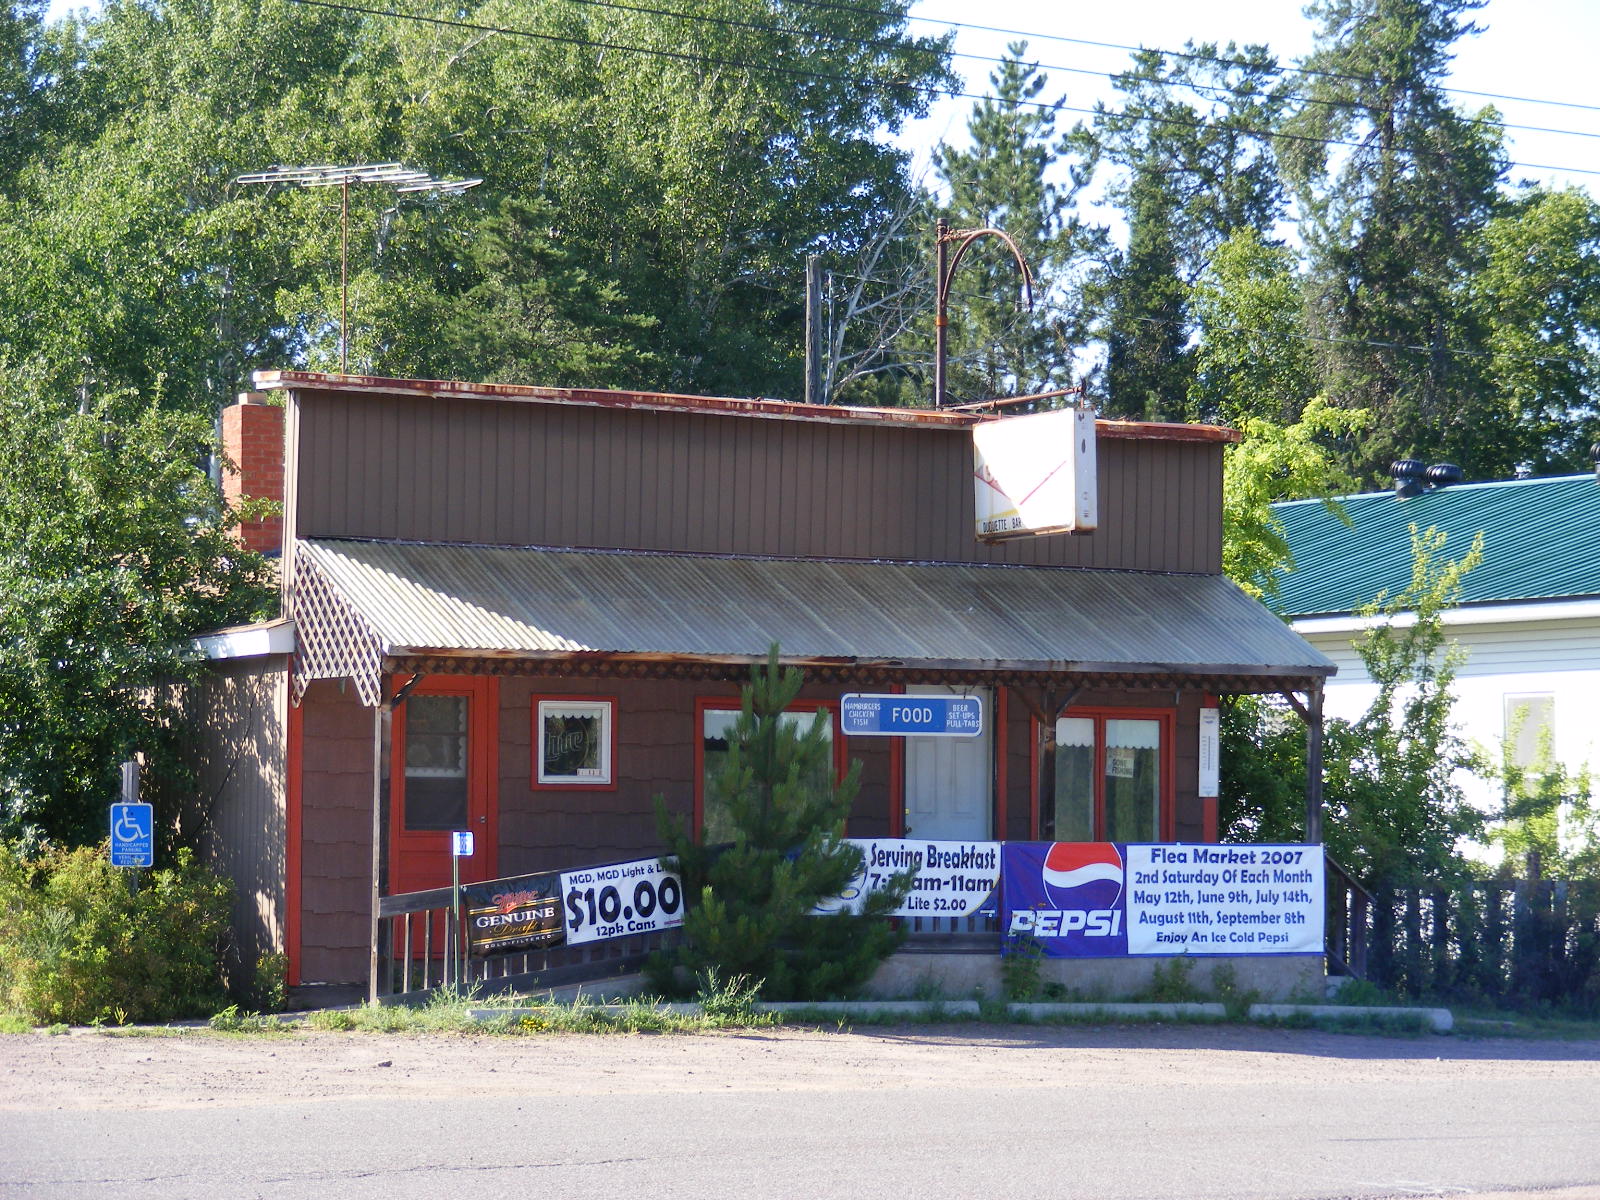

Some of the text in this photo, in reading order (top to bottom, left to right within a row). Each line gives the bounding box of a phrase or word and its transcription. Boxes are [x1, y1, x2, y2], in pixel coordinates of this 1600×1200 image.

[1012, 516, 1022, 529] BAR
[844, 702, 881, 711] HAMBURGERS
[849, 710, 875, 718] CHICKEN
[952, 704, 969, 712] BEER
[853, 718, 869, 726] FISH
[892, 707, 933, 723] FOOD
[948, 711, 976, 719] SET-UPS
[946, 719, 980, 728] PULL-TABS
[870, 842, 996, 871] Serving Breakfast
[1151, 848, 1303, 864] Flea Market 2007
[569, 874, 595, 885] MGD,
[597, 870, 620, 881] MGD
[622, 867, 645, 878] Light
[647, 864, 654, 874] &
[1135, 869, 1313, 886] 2nd Saturday Of Each Month
[566, 876, 681, 933] $10.00
[908, 897, 930, 910] Lite
[933, 898, 967, 911] $2.00
[1134, 889, 1313, 906] May 12th, June 9th, July 14th,
[476, 907, 555, 928] GENUINE
[1008, 909, 1122, 937] PEPSI
[1139, 911, 1305, 926] August 11th, September 8th
[596, 922, 624, 937] 12pk
[627, 920, 656, 932] Cans
[1156, 932, 1289, 944] Enjoy An Ice Cold Pepsi
